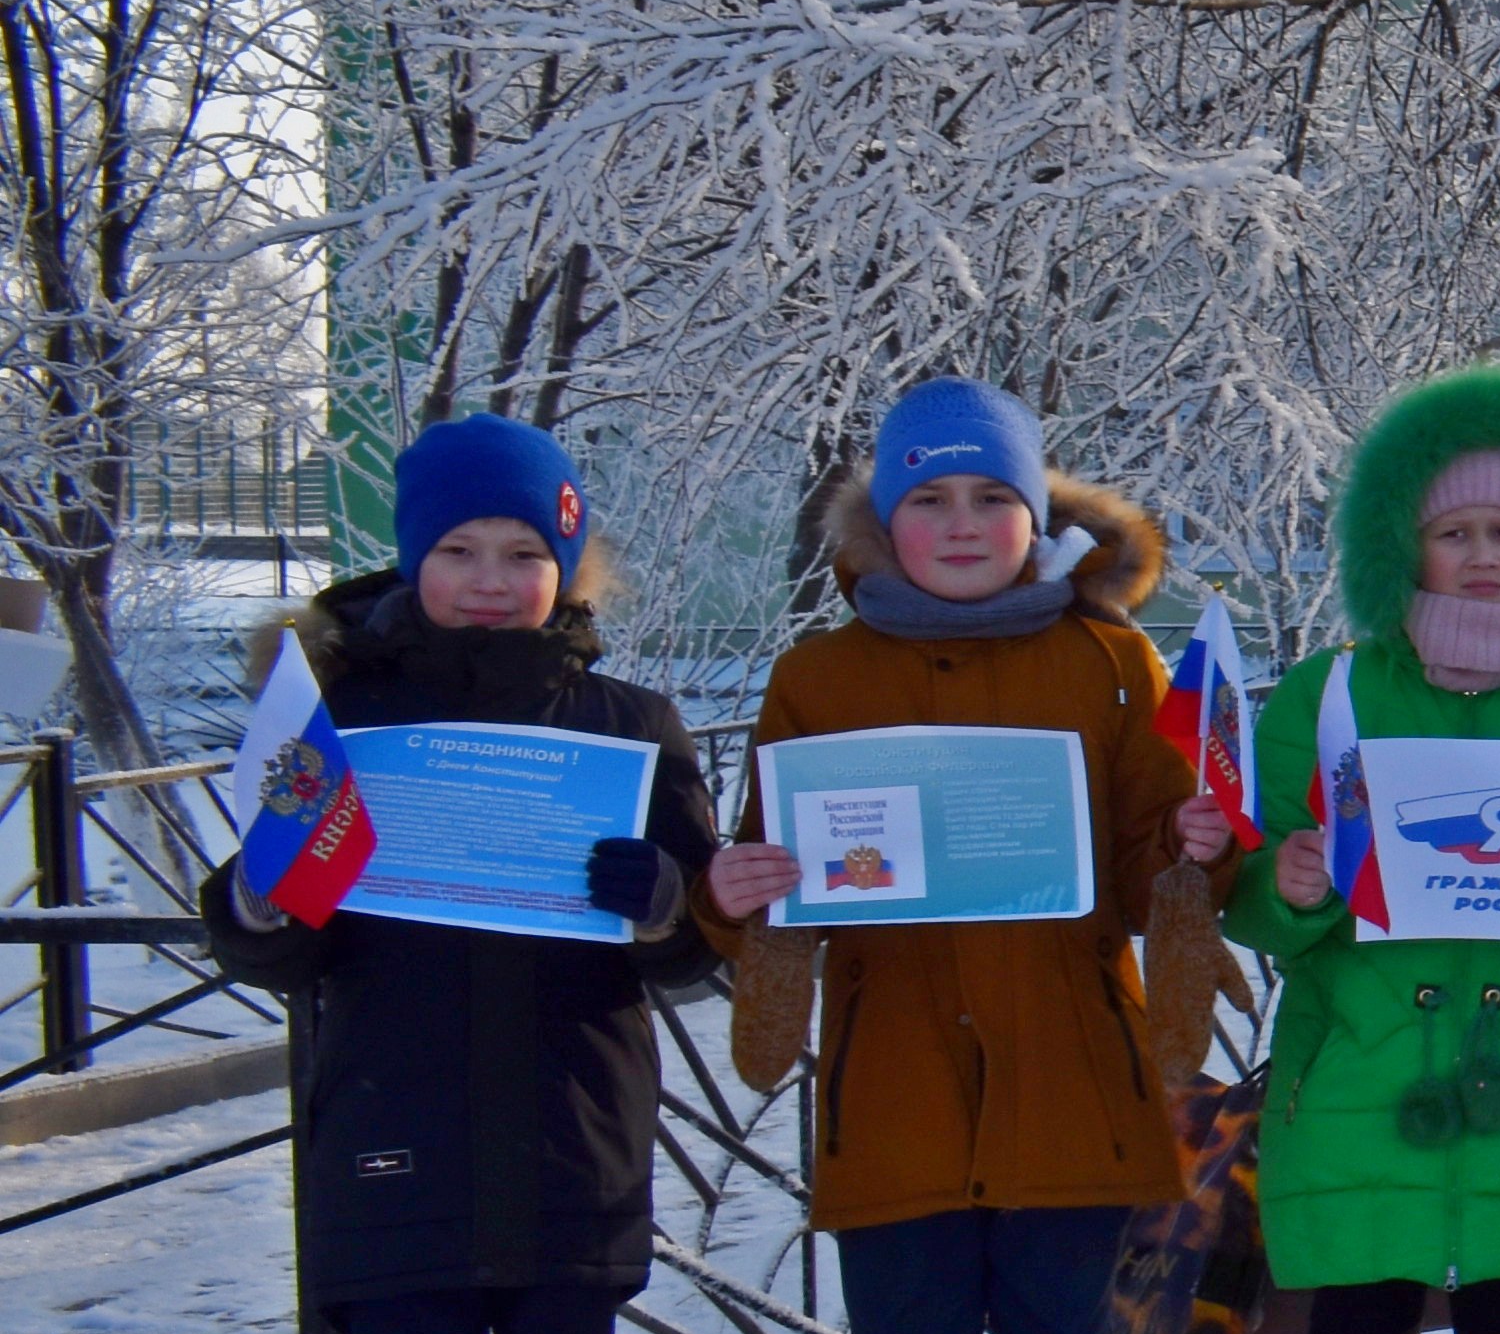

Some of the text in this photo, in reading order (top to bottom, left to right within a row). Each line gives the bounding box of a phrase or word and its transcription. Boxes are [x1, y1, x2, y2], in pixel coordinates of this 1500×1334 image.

[406, 734, 580, 766] С праздником !
